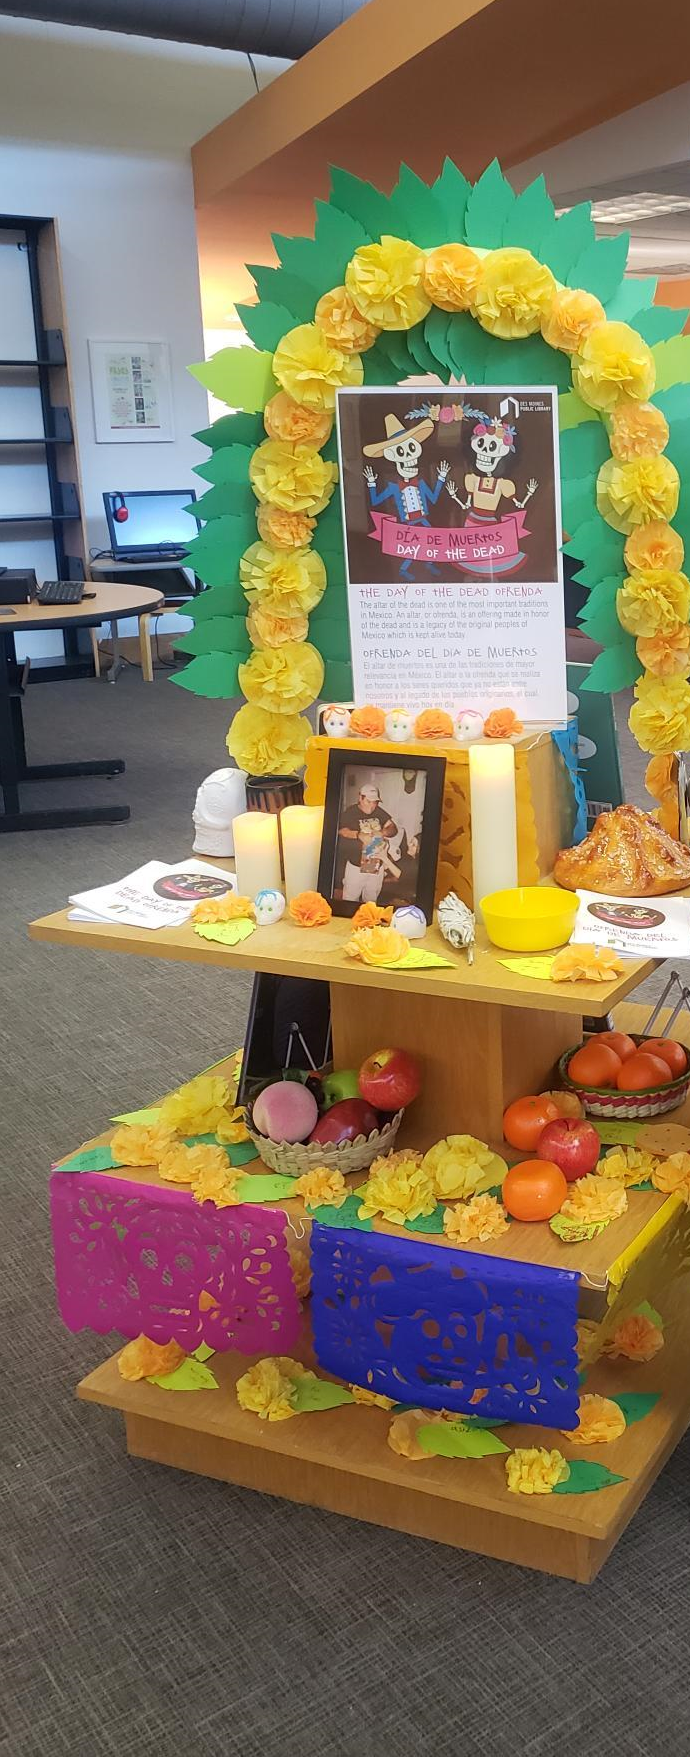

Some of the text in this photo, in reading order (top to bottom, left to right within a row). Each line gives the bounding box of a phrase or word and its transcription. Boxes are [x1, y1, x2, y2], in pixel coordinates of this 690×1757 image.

[427, 535, 442, 545] DE
[450, 532, 502, 547] MUERTOS
[397, 544, 504, 559] DAY OF THE DEAD
[359, 586, 542, 599] THE DAY OF THE DEAD OFRENDA
[486, 600, 516, 609] important
[478, 611, 502, 619] offering
[426, 621, 447, 630] legacy
[468, 620, 492, 629] original
[494, 620, 520, 629] peoples
[362, 631, 386, 639] Mexico
[416, 631, 430, 640] kept
[363, 648, 412, 659] OFRENDA
[418, 647, 438, 658] DEL
[468, 648, 482, 658] DE
[488, 646, 538, 658] MUERTOS
